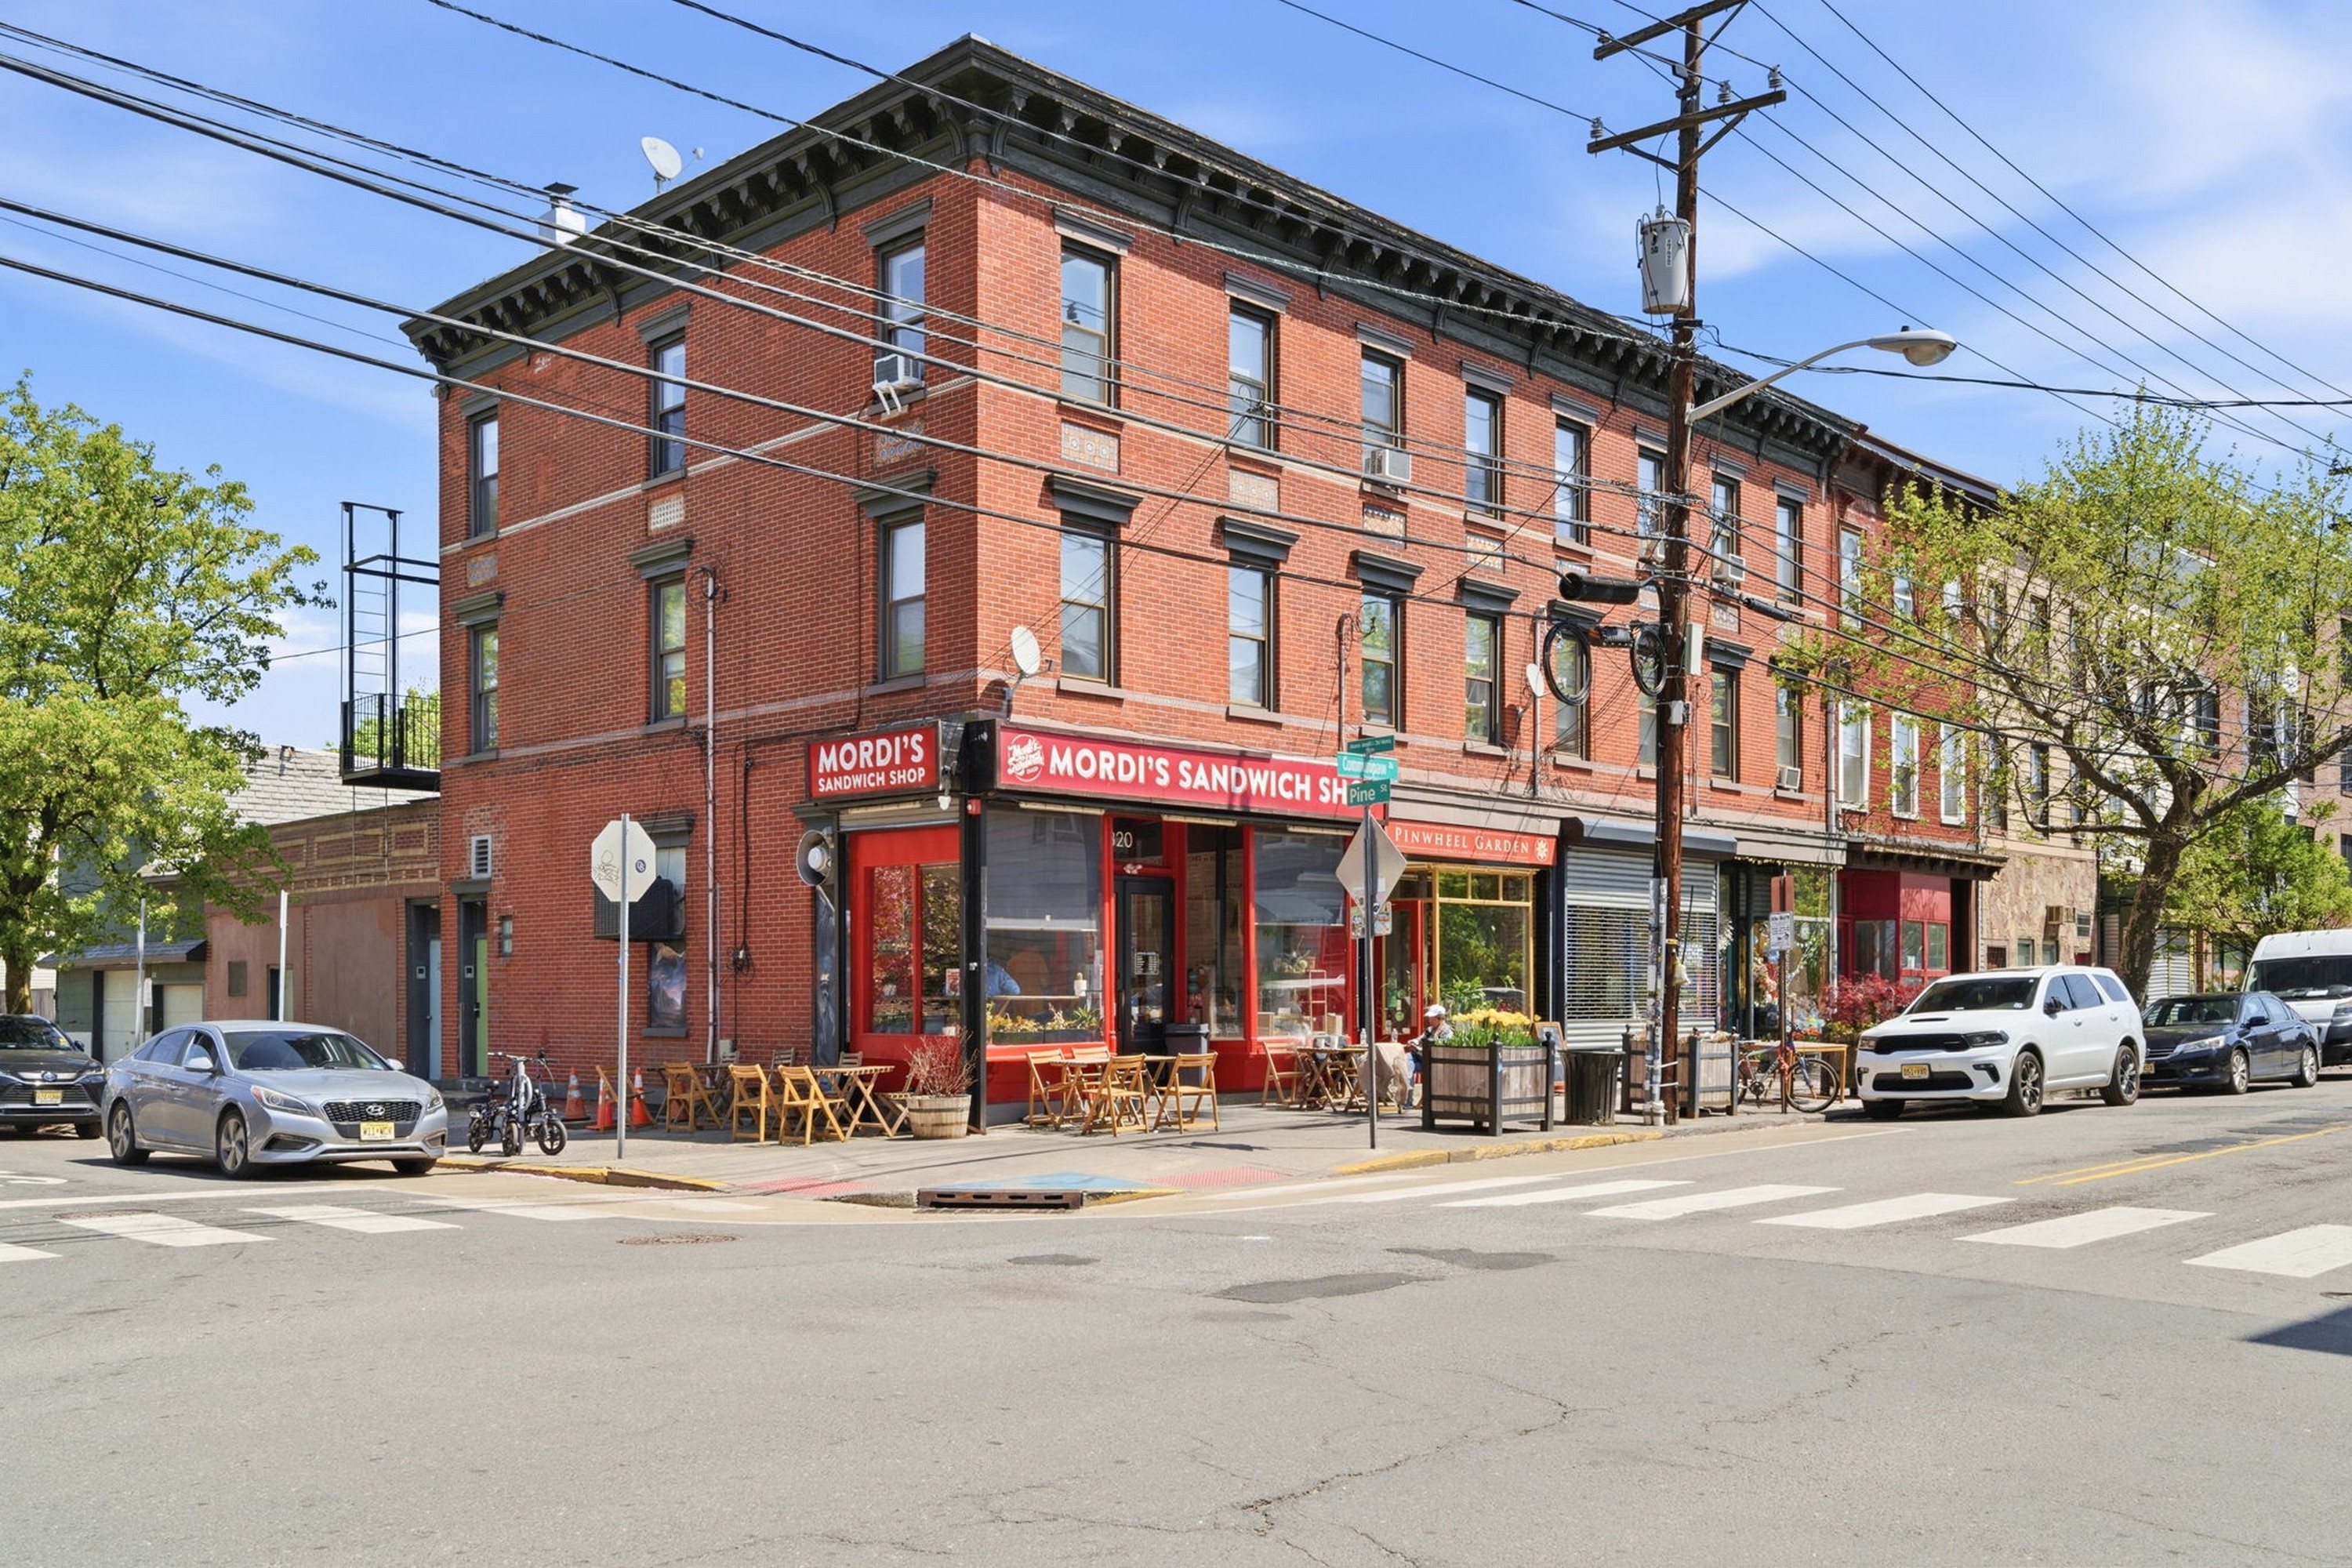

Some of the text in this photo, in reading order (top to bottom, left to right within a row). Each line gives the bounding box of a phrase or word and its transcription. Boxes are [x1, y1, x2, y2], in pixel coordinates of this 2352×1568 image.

[818, 733, 924, 774] MORDI'S
[818, 767, 926, 792] SANDWICH SHOP
[1049, 744, 1363, 805] MORDI'S SANDWICH SH
[1350, 786, 1375, 804] Pine
[1395, 826, 1529, 854] PINWHEEL GARDEN
